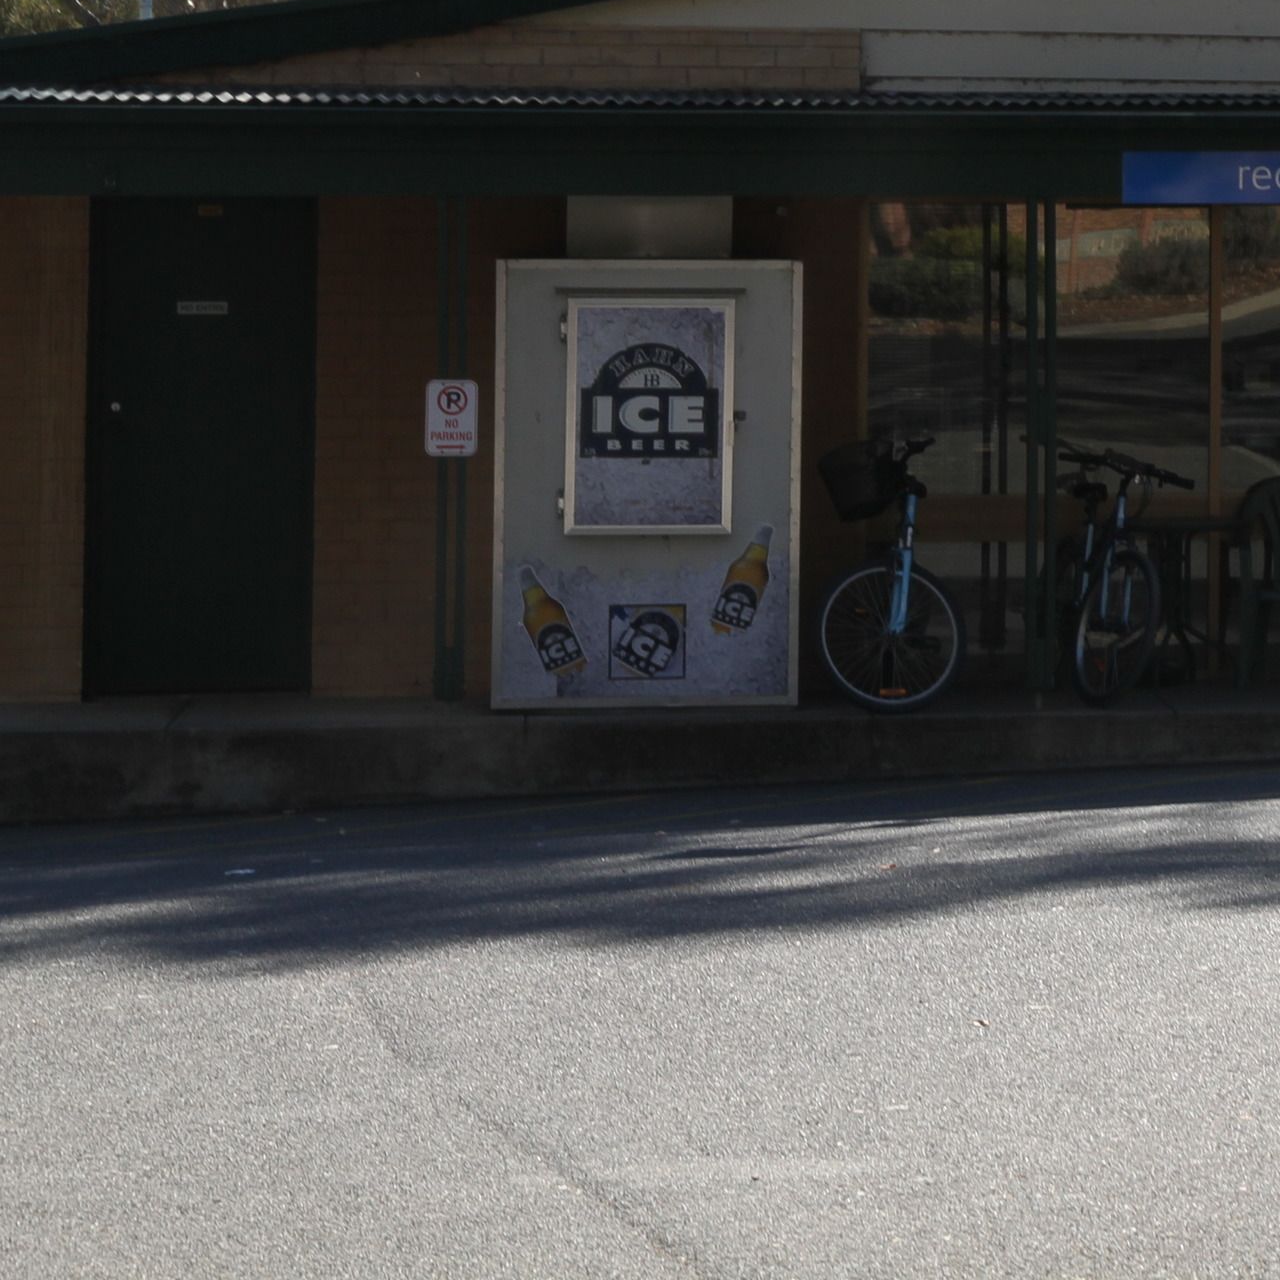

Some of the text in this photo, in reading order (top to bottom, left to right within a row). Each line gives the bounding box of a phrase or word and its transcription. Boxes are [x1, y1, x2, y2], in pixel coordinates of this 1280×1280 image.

[609, 347, 695, 378] HAHN
[444, 419, 459, 428] NO
[592, 395, 705, 434] ICE
[430, 431, 473, 441] PARKING
[606, 439, 691, 451] BEER
[715, 597, 756, 621] ICE
[540, 636, 580, 664] ICE
[618, 628, 674, 670] ICE
